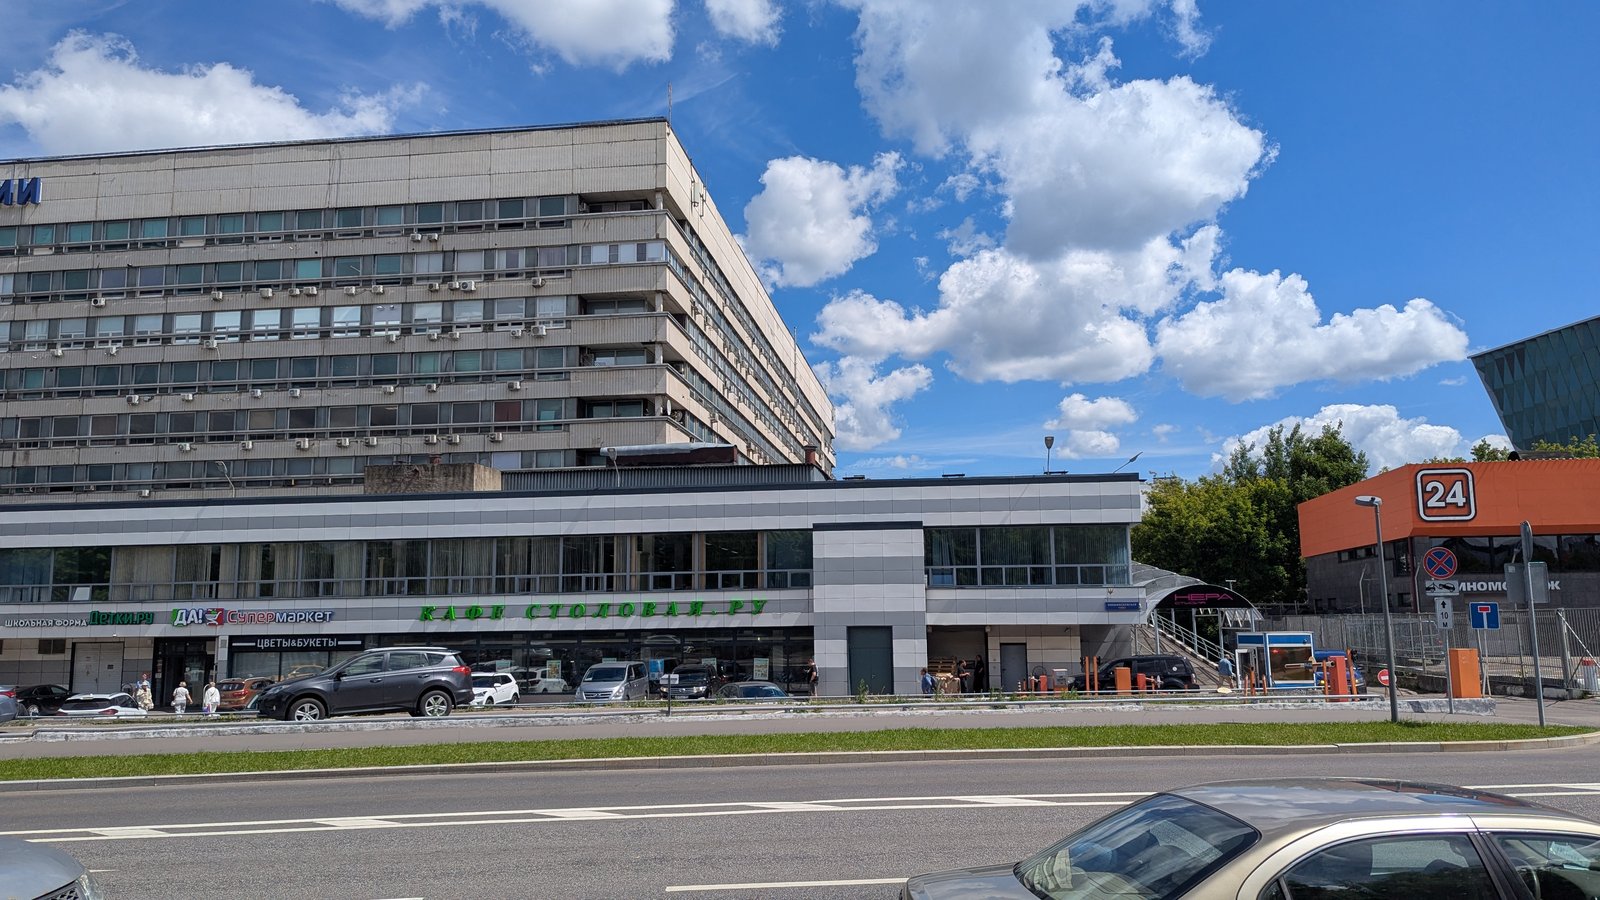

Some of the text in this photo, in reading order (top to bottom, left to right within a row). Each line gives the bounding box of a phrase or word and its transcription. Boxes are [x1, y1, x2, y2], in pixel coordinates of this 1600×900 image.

[1425, 480, 1467, 508] 24
[173, 609, 334, 626] ДА! Супермаркет
[419, 604, 505, 621] КАФЕ
[1441, 611, 1449, 620] 10
[5, 619, 87, 627] ШКОЛЬНАЯ ФОРМА
[256, 638, 337, 649] ЦВЕТЫ&БУКЕТЫ
